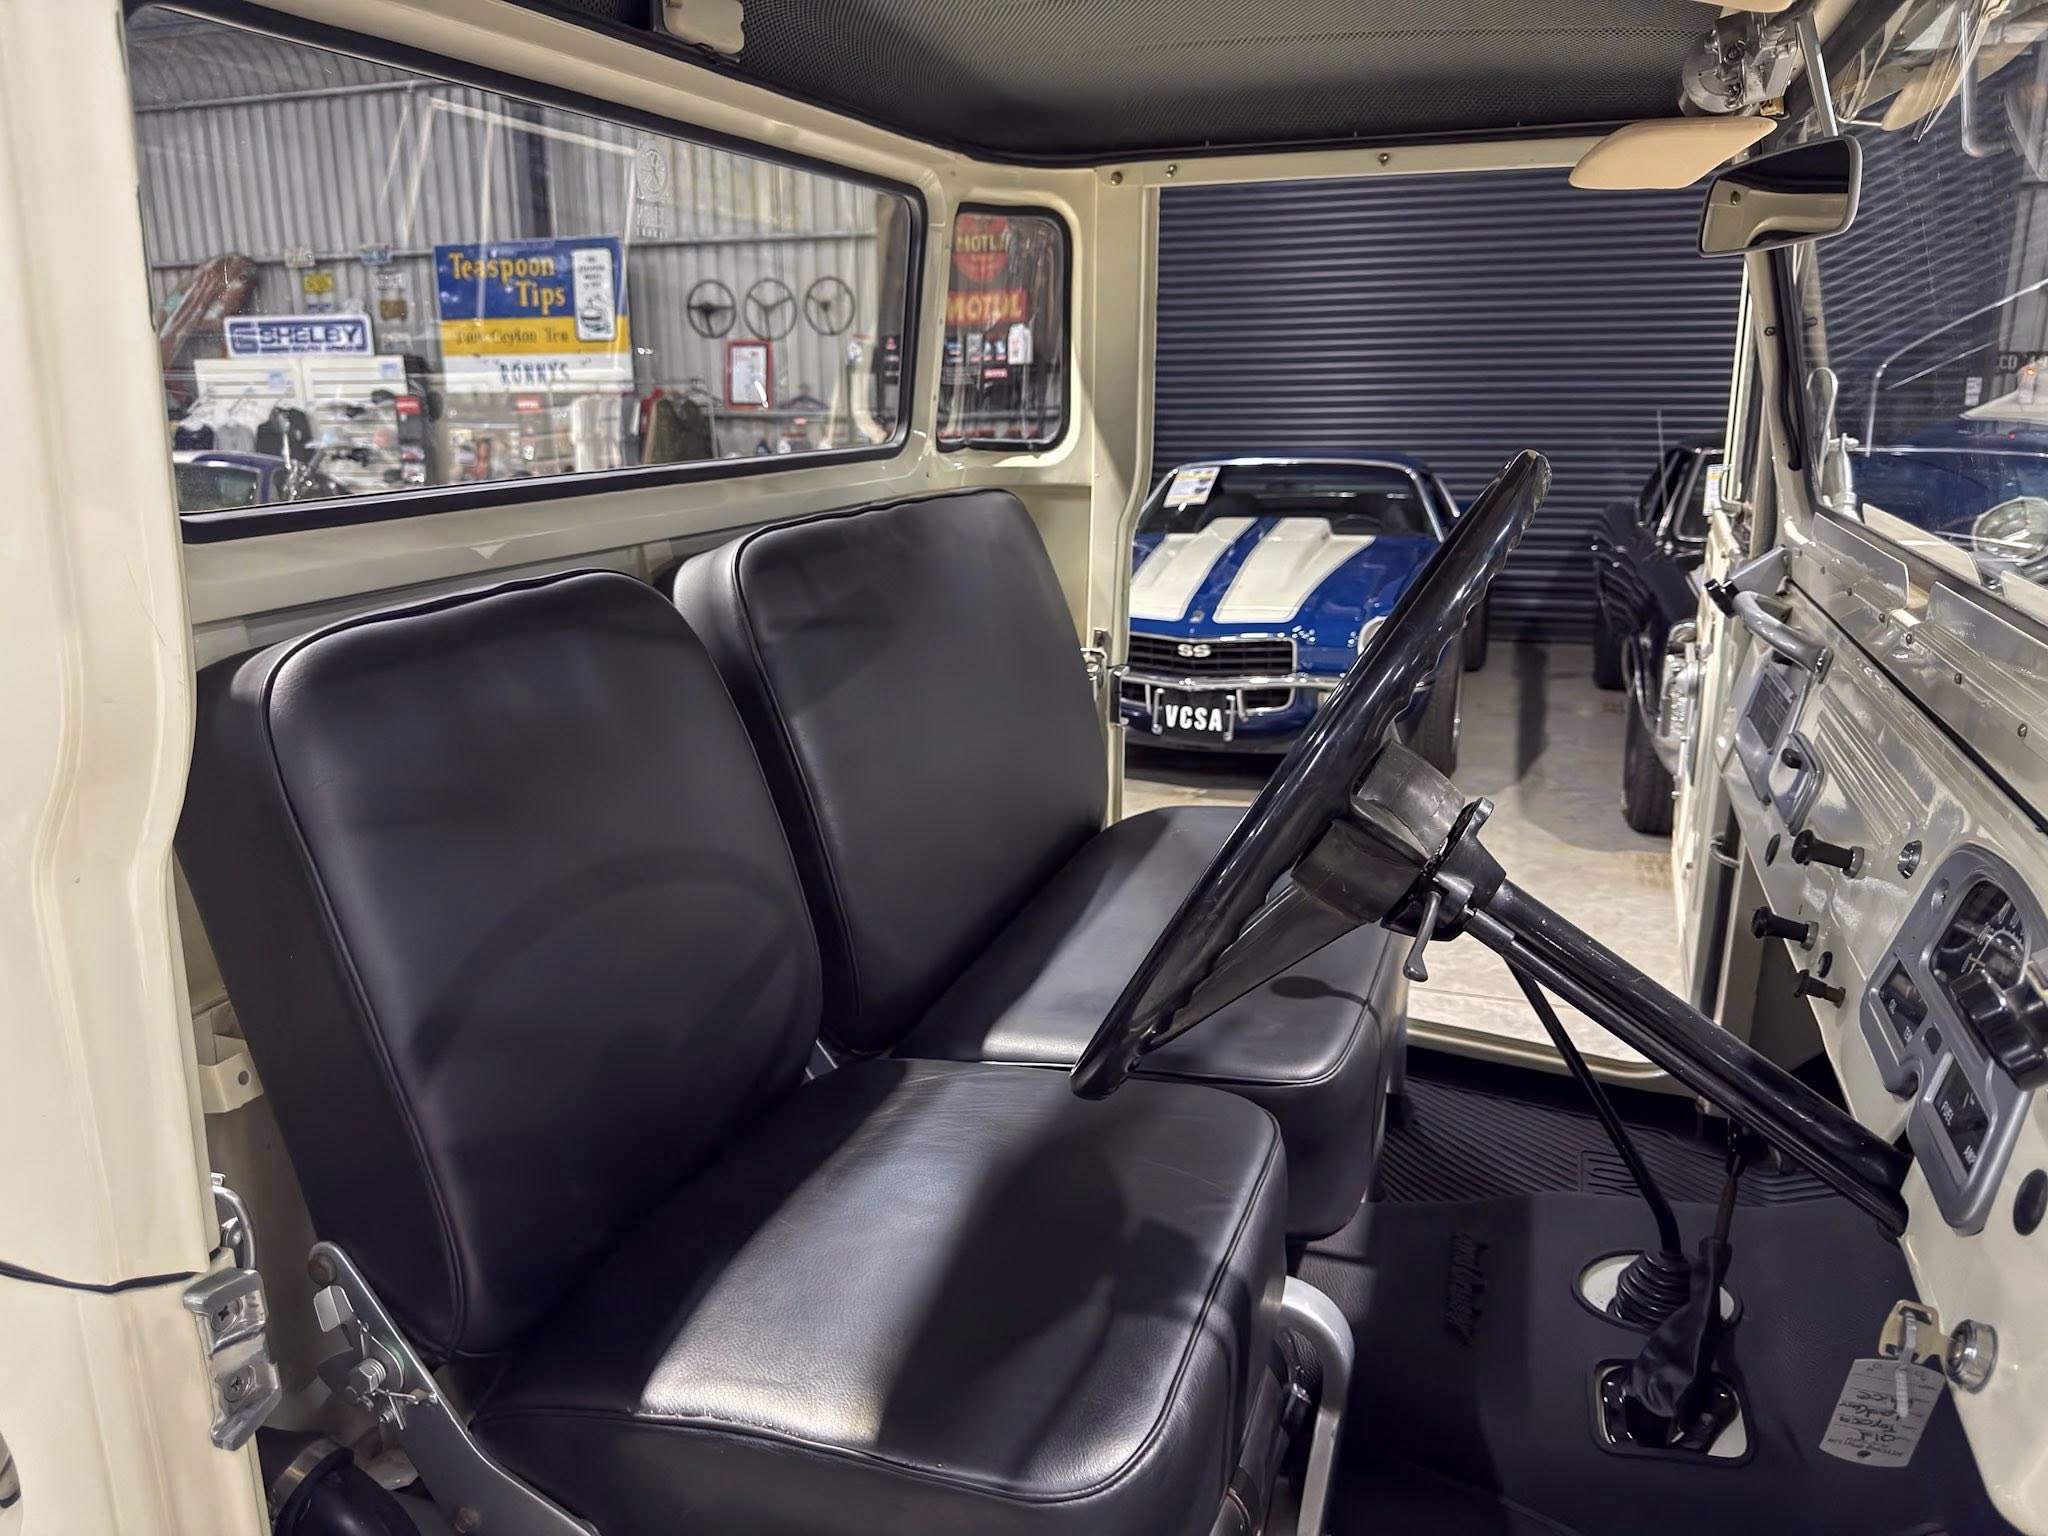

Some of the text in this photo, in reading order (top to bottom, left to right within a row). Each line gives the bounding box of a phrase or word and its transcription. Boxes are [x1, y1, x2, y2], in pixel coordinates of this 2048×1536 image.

[449, 252, 555, 285] Teaspoon
[515, 280, 566, 315] Tips
[947, 293, 1022, 319] MOTUL
[259, 326, 361, 345] SHELBY
[1177, 644, 1211, 658] SS
[1165, 704, 1222, 732] VCSA
